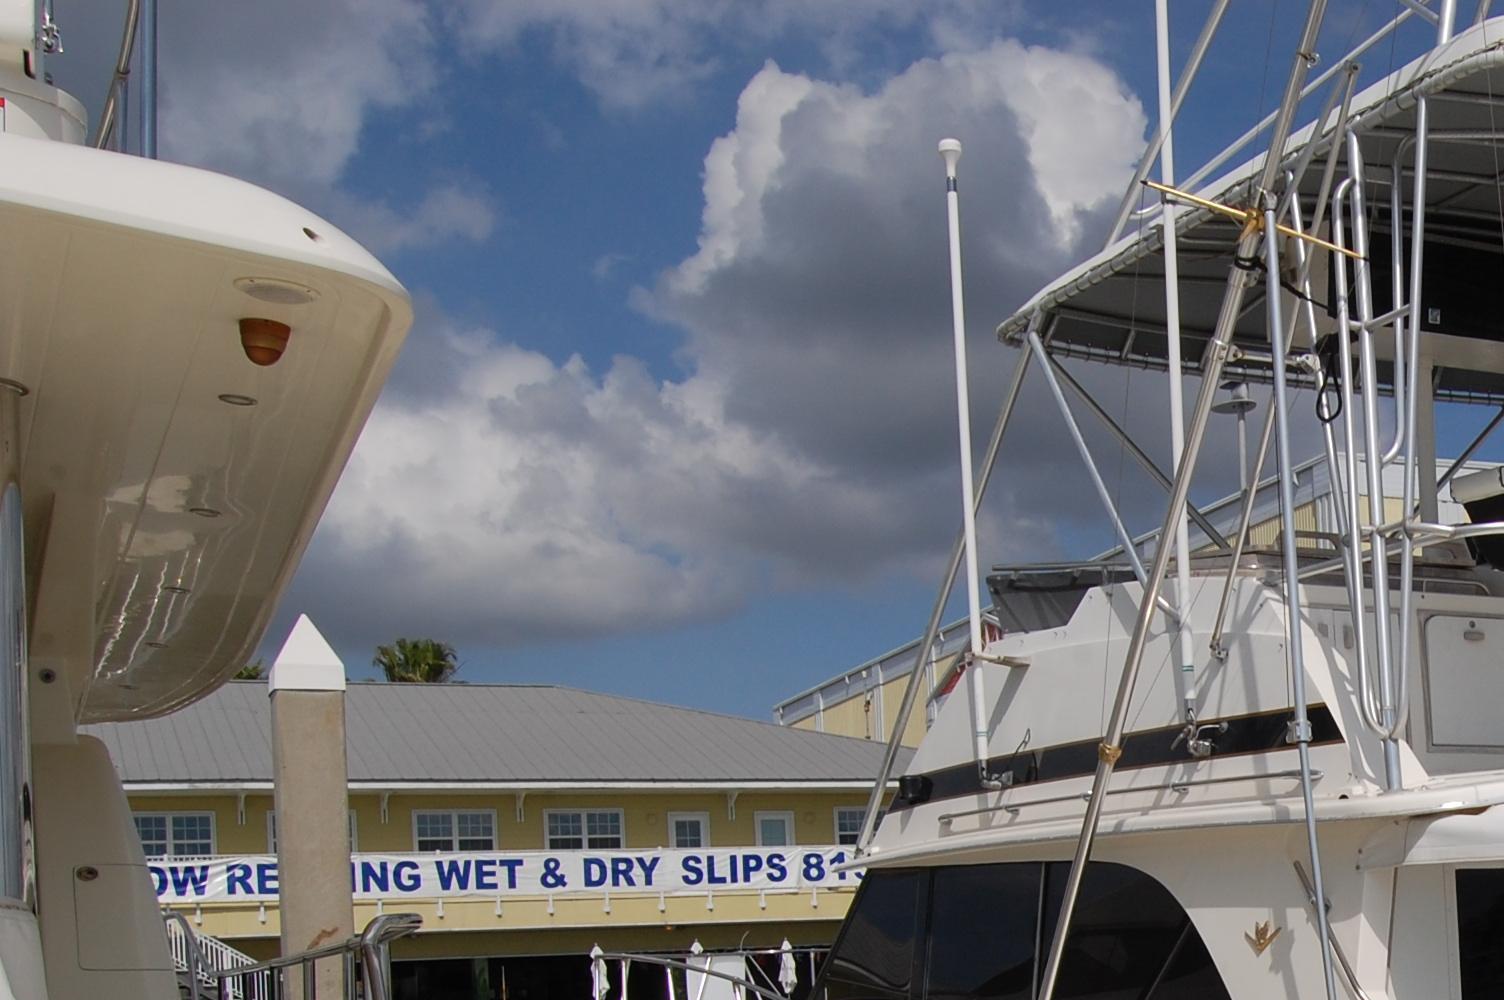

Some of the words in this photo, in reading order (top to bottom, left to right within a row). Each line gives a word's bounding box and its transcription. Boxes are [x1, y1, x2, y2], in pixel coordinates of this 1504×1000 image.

[436, 858, 523, 891] WET
[540, 857, 567, 888] &
[584, 856, 661, 888] DRY
[681, 852, 788, 886] SLIPS
[802, 851, 864, 882] 81
